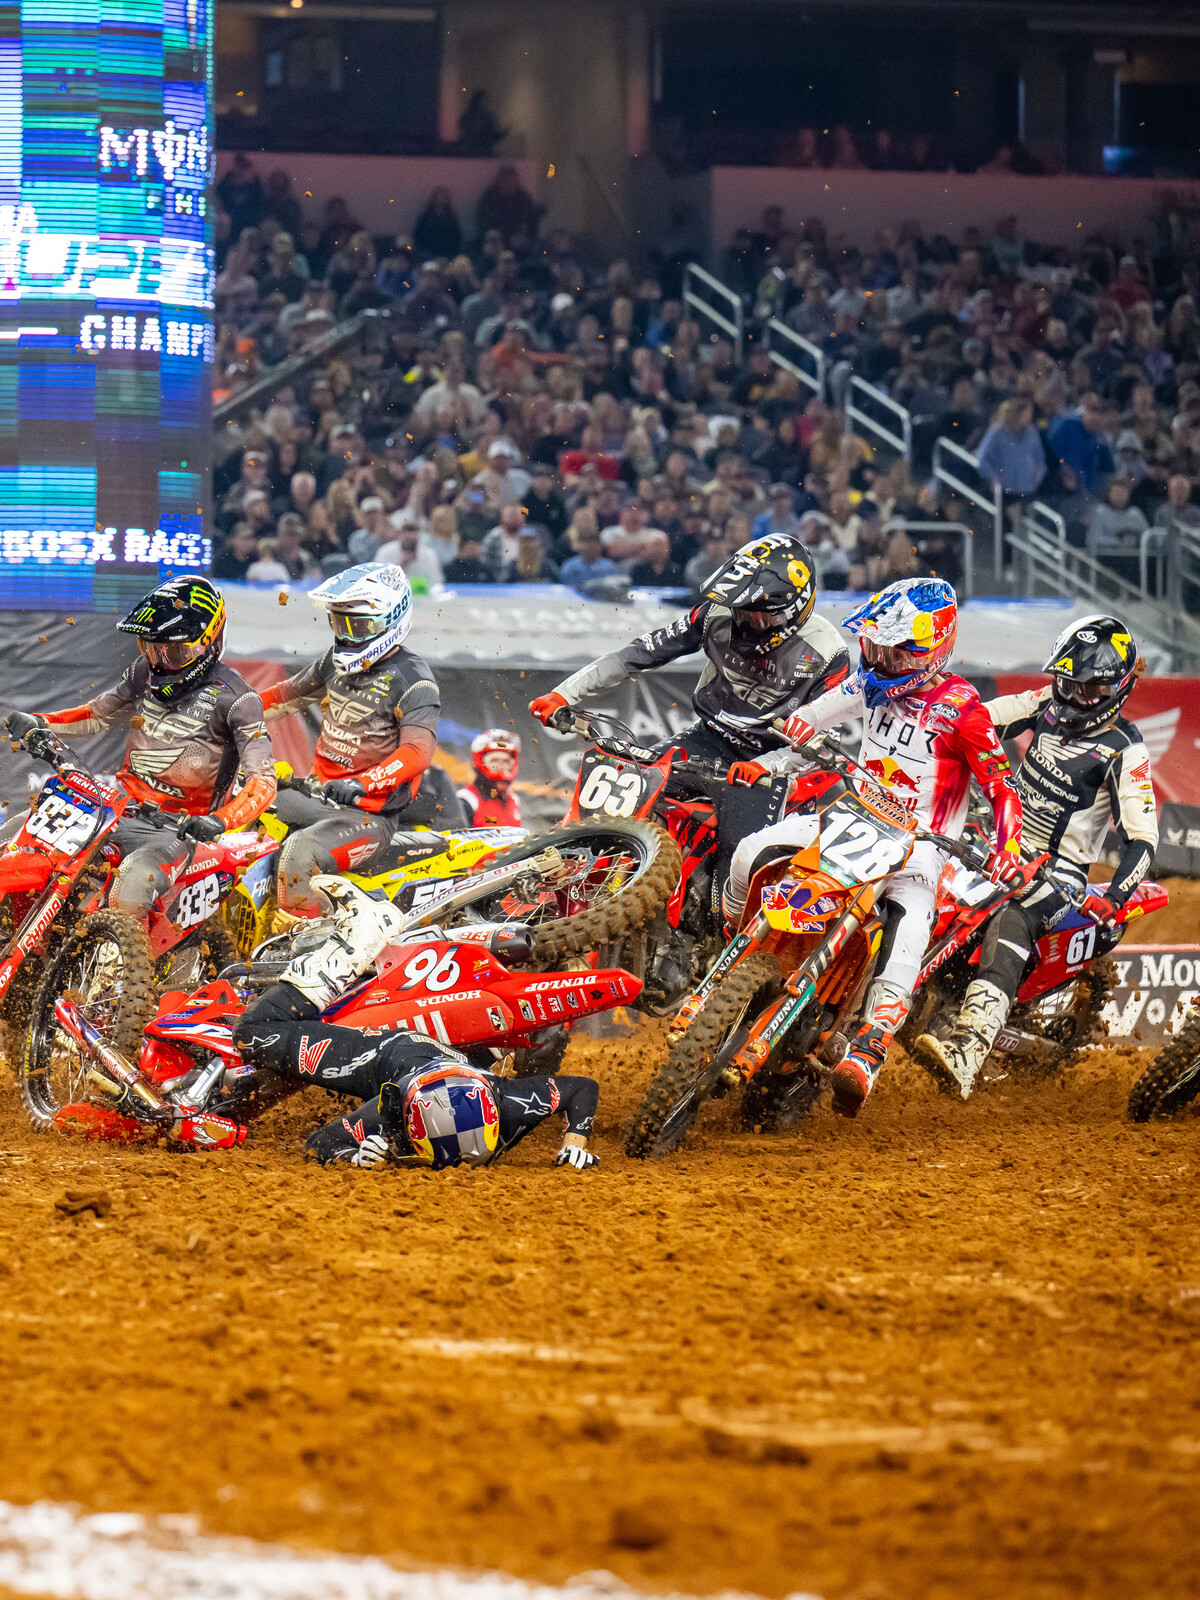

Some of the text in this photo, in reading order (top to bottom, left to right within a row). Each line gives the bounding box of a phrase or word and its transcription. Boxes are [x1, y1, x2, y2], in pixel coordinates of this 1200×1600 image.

[347, 625, 404, 672] PROGRESSIVE
[932, 703, 958, 718] Airoh
[1028, 747, 1074, 787] HONDA
[579, 764, 647, 818] 63
[1041, 776, 1080, 803] RACING
[26, 794, 99, 857] 832
[820, 811, 905, 881] 128
[185, 857, 220, 875] HONDA
[176, 873, 221, 930] 832
[1065, 925, 1097, 966] 67
[396, 945, 462, 992] 96
[524, 975, 598, 992] DUNLOP
[700, 943, 740, 999] DUNOP
[415, 989, 482, 1008] HONDA
[299, 1035, 307, 1074] HONDA
